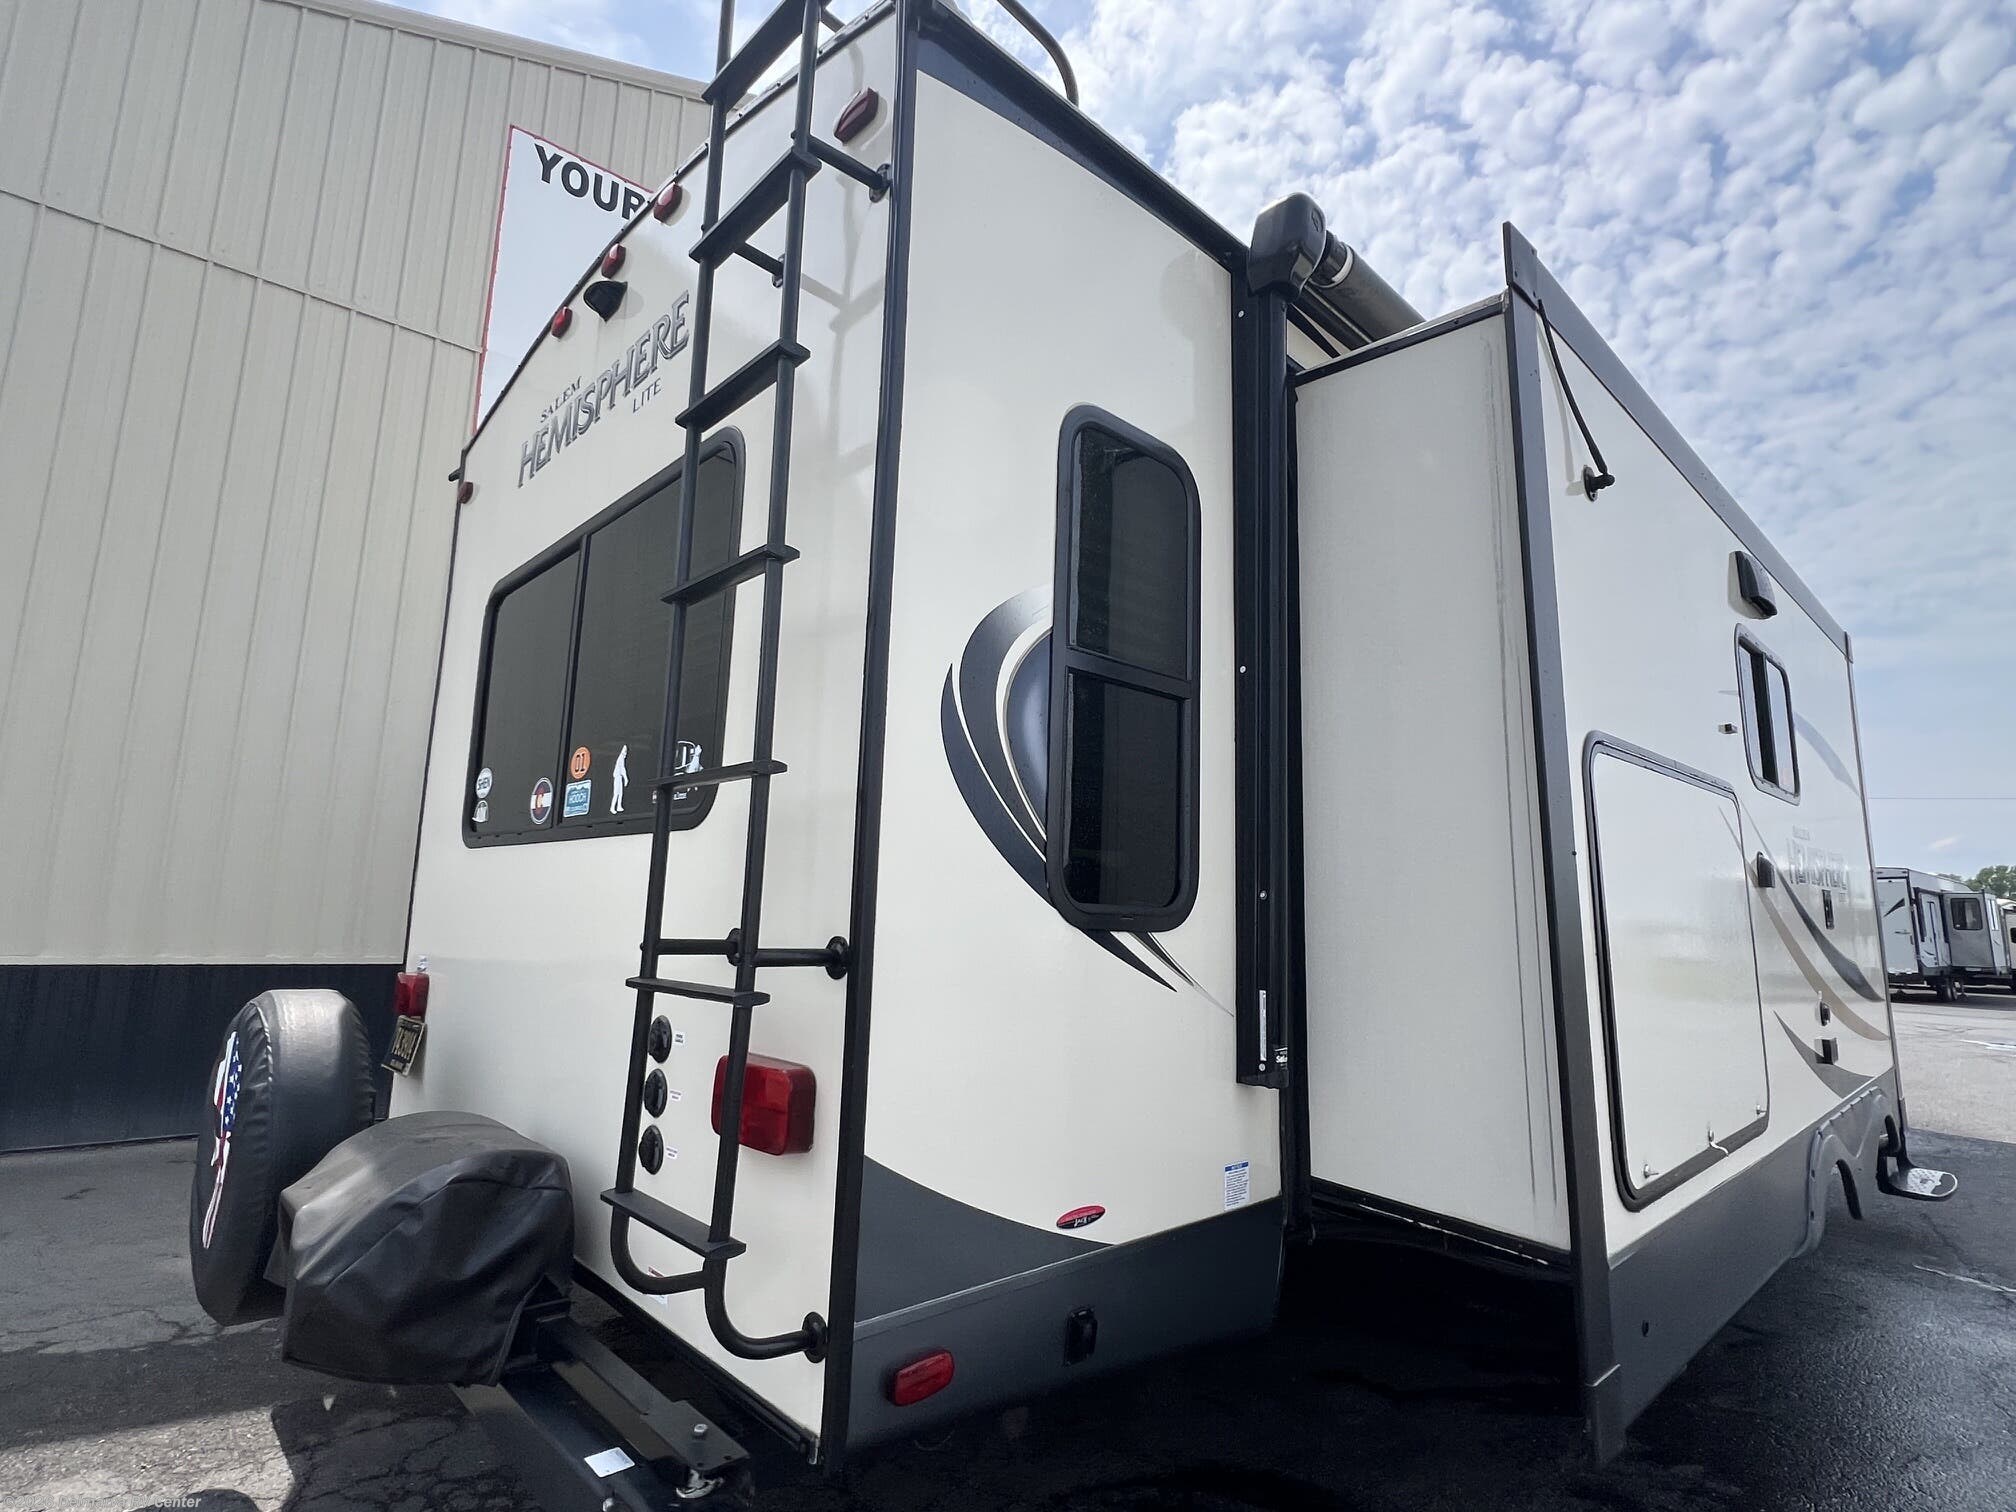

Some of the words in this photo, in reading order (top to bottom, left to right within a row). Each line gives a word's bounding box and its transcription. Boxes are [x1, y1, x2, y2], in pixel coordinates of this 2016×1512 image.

[534, 143, 646, 220] YOUR
[518, 289, 690, 489] HEMISPHERE
[540, 376, 583, 423] SALEM
[633, 377, 662, 414] LITE
